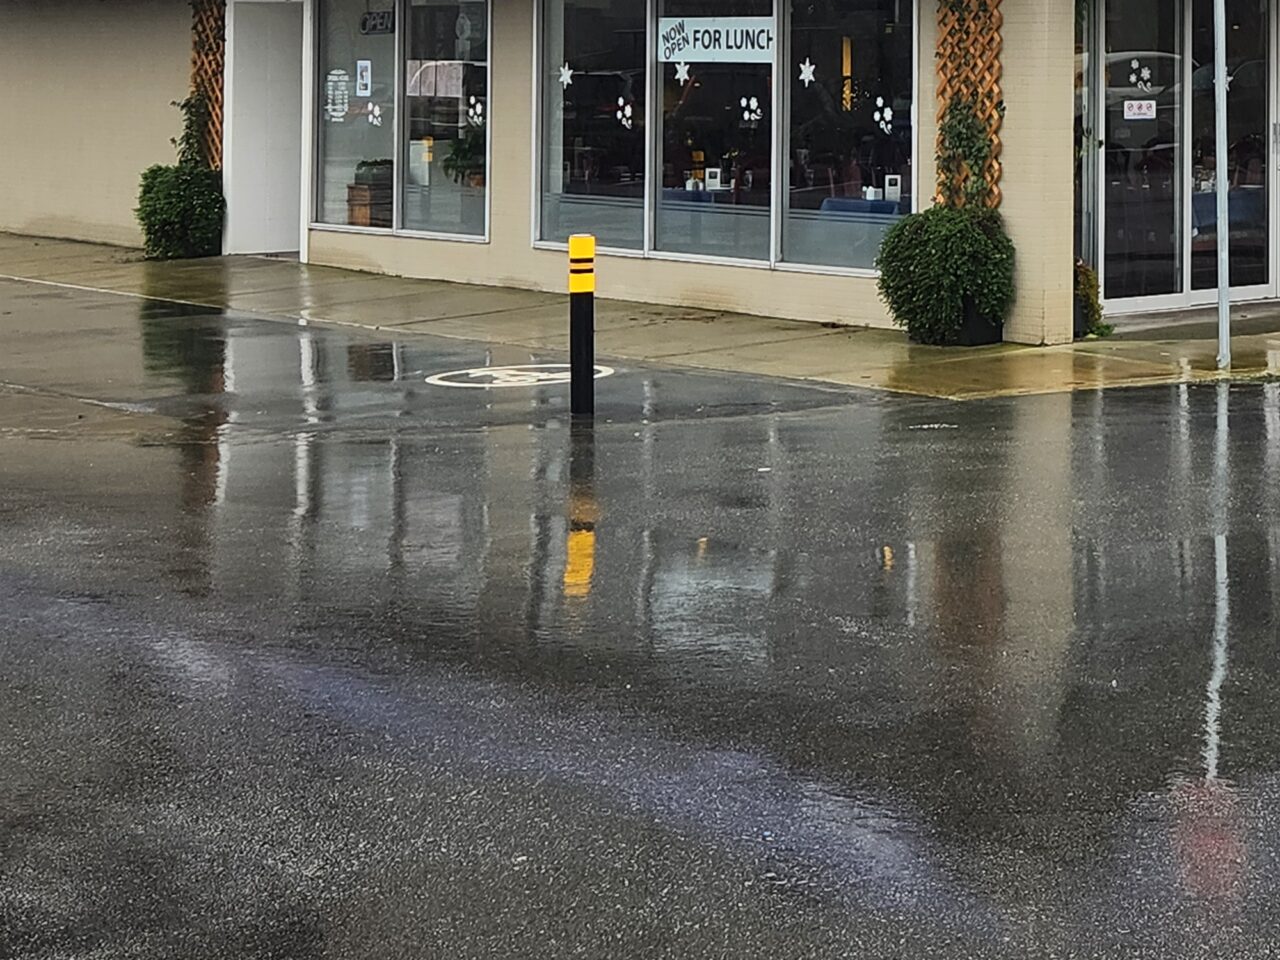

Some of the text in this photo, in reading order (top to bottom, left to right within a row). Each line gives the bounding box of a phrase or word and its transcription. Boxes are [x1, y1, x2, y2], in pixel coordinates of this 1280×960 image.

[360, 11, 393, 34] OPEN
[662, 20, 685, 46] NOW
[664, 33, 690, 60] OPEN
[693, 29, 722, 49] FOR
